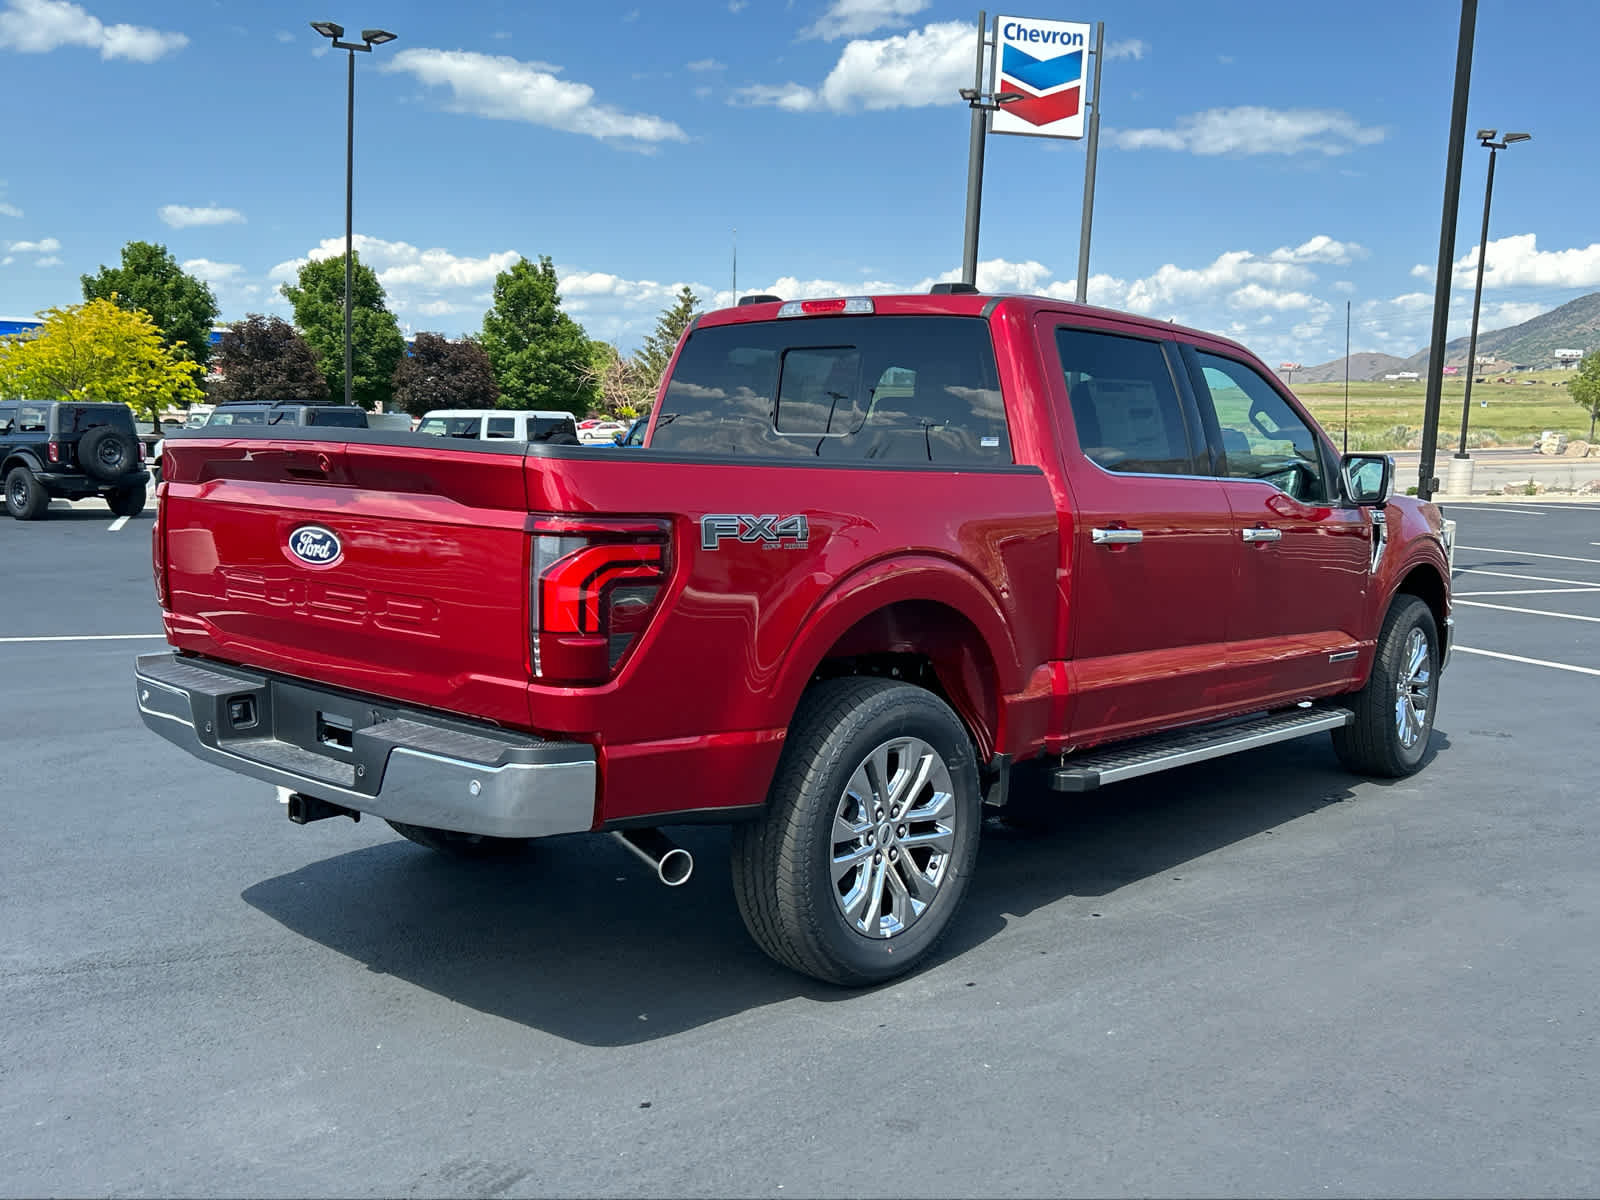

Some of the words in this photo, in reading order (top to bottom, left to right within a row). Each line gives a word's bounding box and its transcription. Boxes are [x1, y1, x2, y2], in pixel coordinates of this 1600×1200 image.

[1003, 22, 1083, 46] Chevron
[297, 531, 331, 559] Ford
[701, 514, 808, 551] FX4
